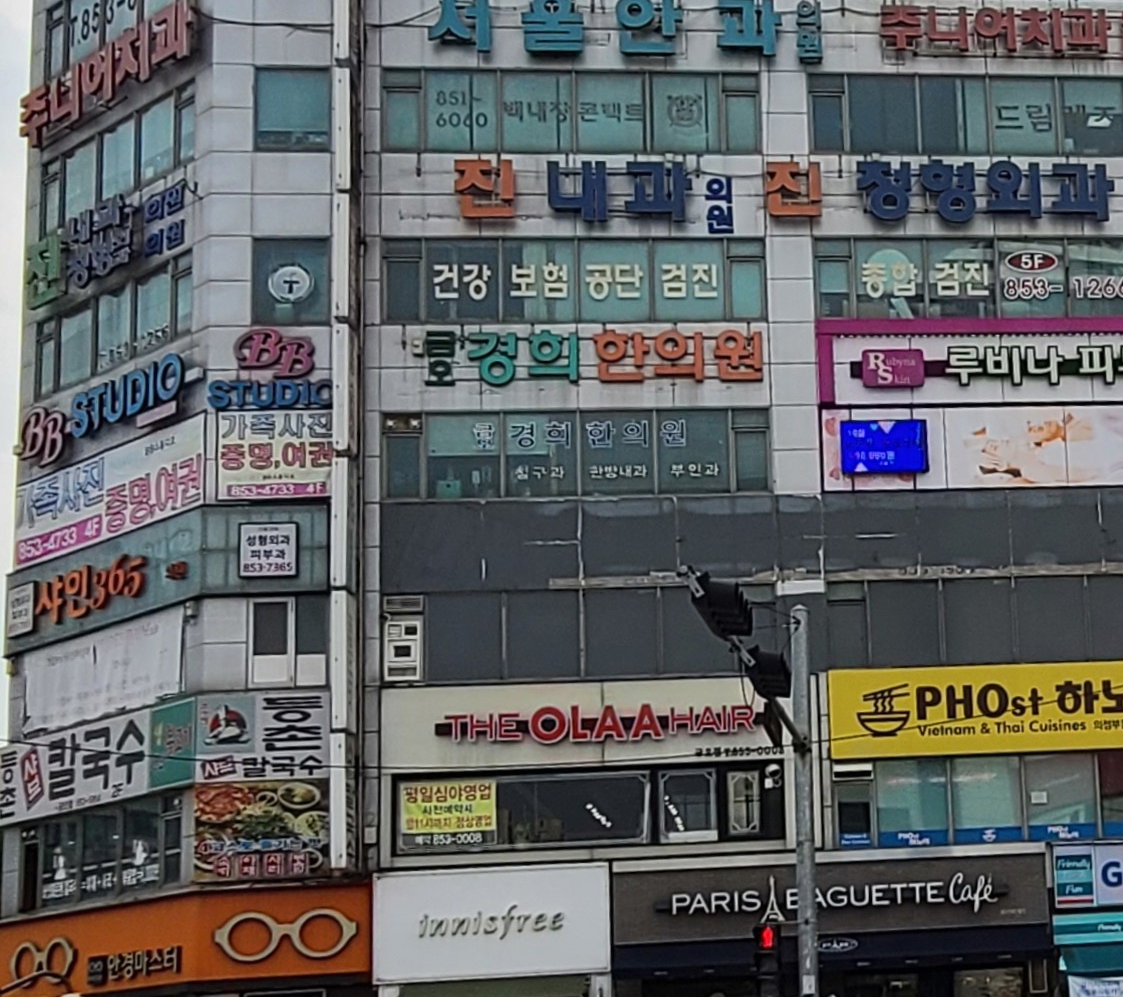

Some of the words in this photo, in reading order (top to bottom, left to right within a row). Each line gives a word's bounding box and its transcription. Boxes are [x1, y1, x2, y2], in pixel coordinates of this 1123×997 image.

[881, 3, 1111, 55] 주니어치과
[454, 159, 516, 219] 진
[547, 160, 693, 223] 내과
[766, 161, 822, 218] 진
[856, 159, 1116, 224] 정형외과
[861, 261, 917, 299] 종합
[934, 262, 990, 298] 검진
[1019, 255, 1045, 269] 5F
[432, 263, 492, 301] 건강
[510, 262, 569, 299] 보험
[585, 263, 644, 301] 공단
[660, 262, 719, 299] 검진
[468, 329, 582, 386] 경희
[593, 327, 764, 384] 한의원
[944, 344, 1065, 387] 루비나
[70, 352, 185, 439] STUDIO
[207, 379, 333, 410] STUDIO
[220, 413, 333, 440] 가족사진
[509, 420, 573, 450] 경희
[584, 418, 688, 450] 한의원
[229, 484, 296, 497] 853-4733
[246, 534, 291, 548] 성형외과
[242, 561, 294, 574] 853-7365
[915, 682, 1045, 721] PHOst
[261, 694, 324, 752] 등촌
[444, 712, 522, 743] THE
[527, 703, 663, 744] OLAA
[667, 704, 757, 734] HAIR
[918, 723, 976, 737] Vietnam
[980, 723, 990, 735] &
[994, 720, 1025, 734] Thai
[1029, 718, 1087, 733] Cuisines
[48, 718, 146, 801] 칼국수
[241, 754, 325, 778] 칼국수
[404, 784, 492, 804] 평일심야영업
[432, 831, 483, 845] 853-0008
[671, 890, 762, 915] PARIS
[949, 871, 998, 913] Café
[418, 904, 566, 940] innisfree
[106, 946, 180, 981] 안경마스터
